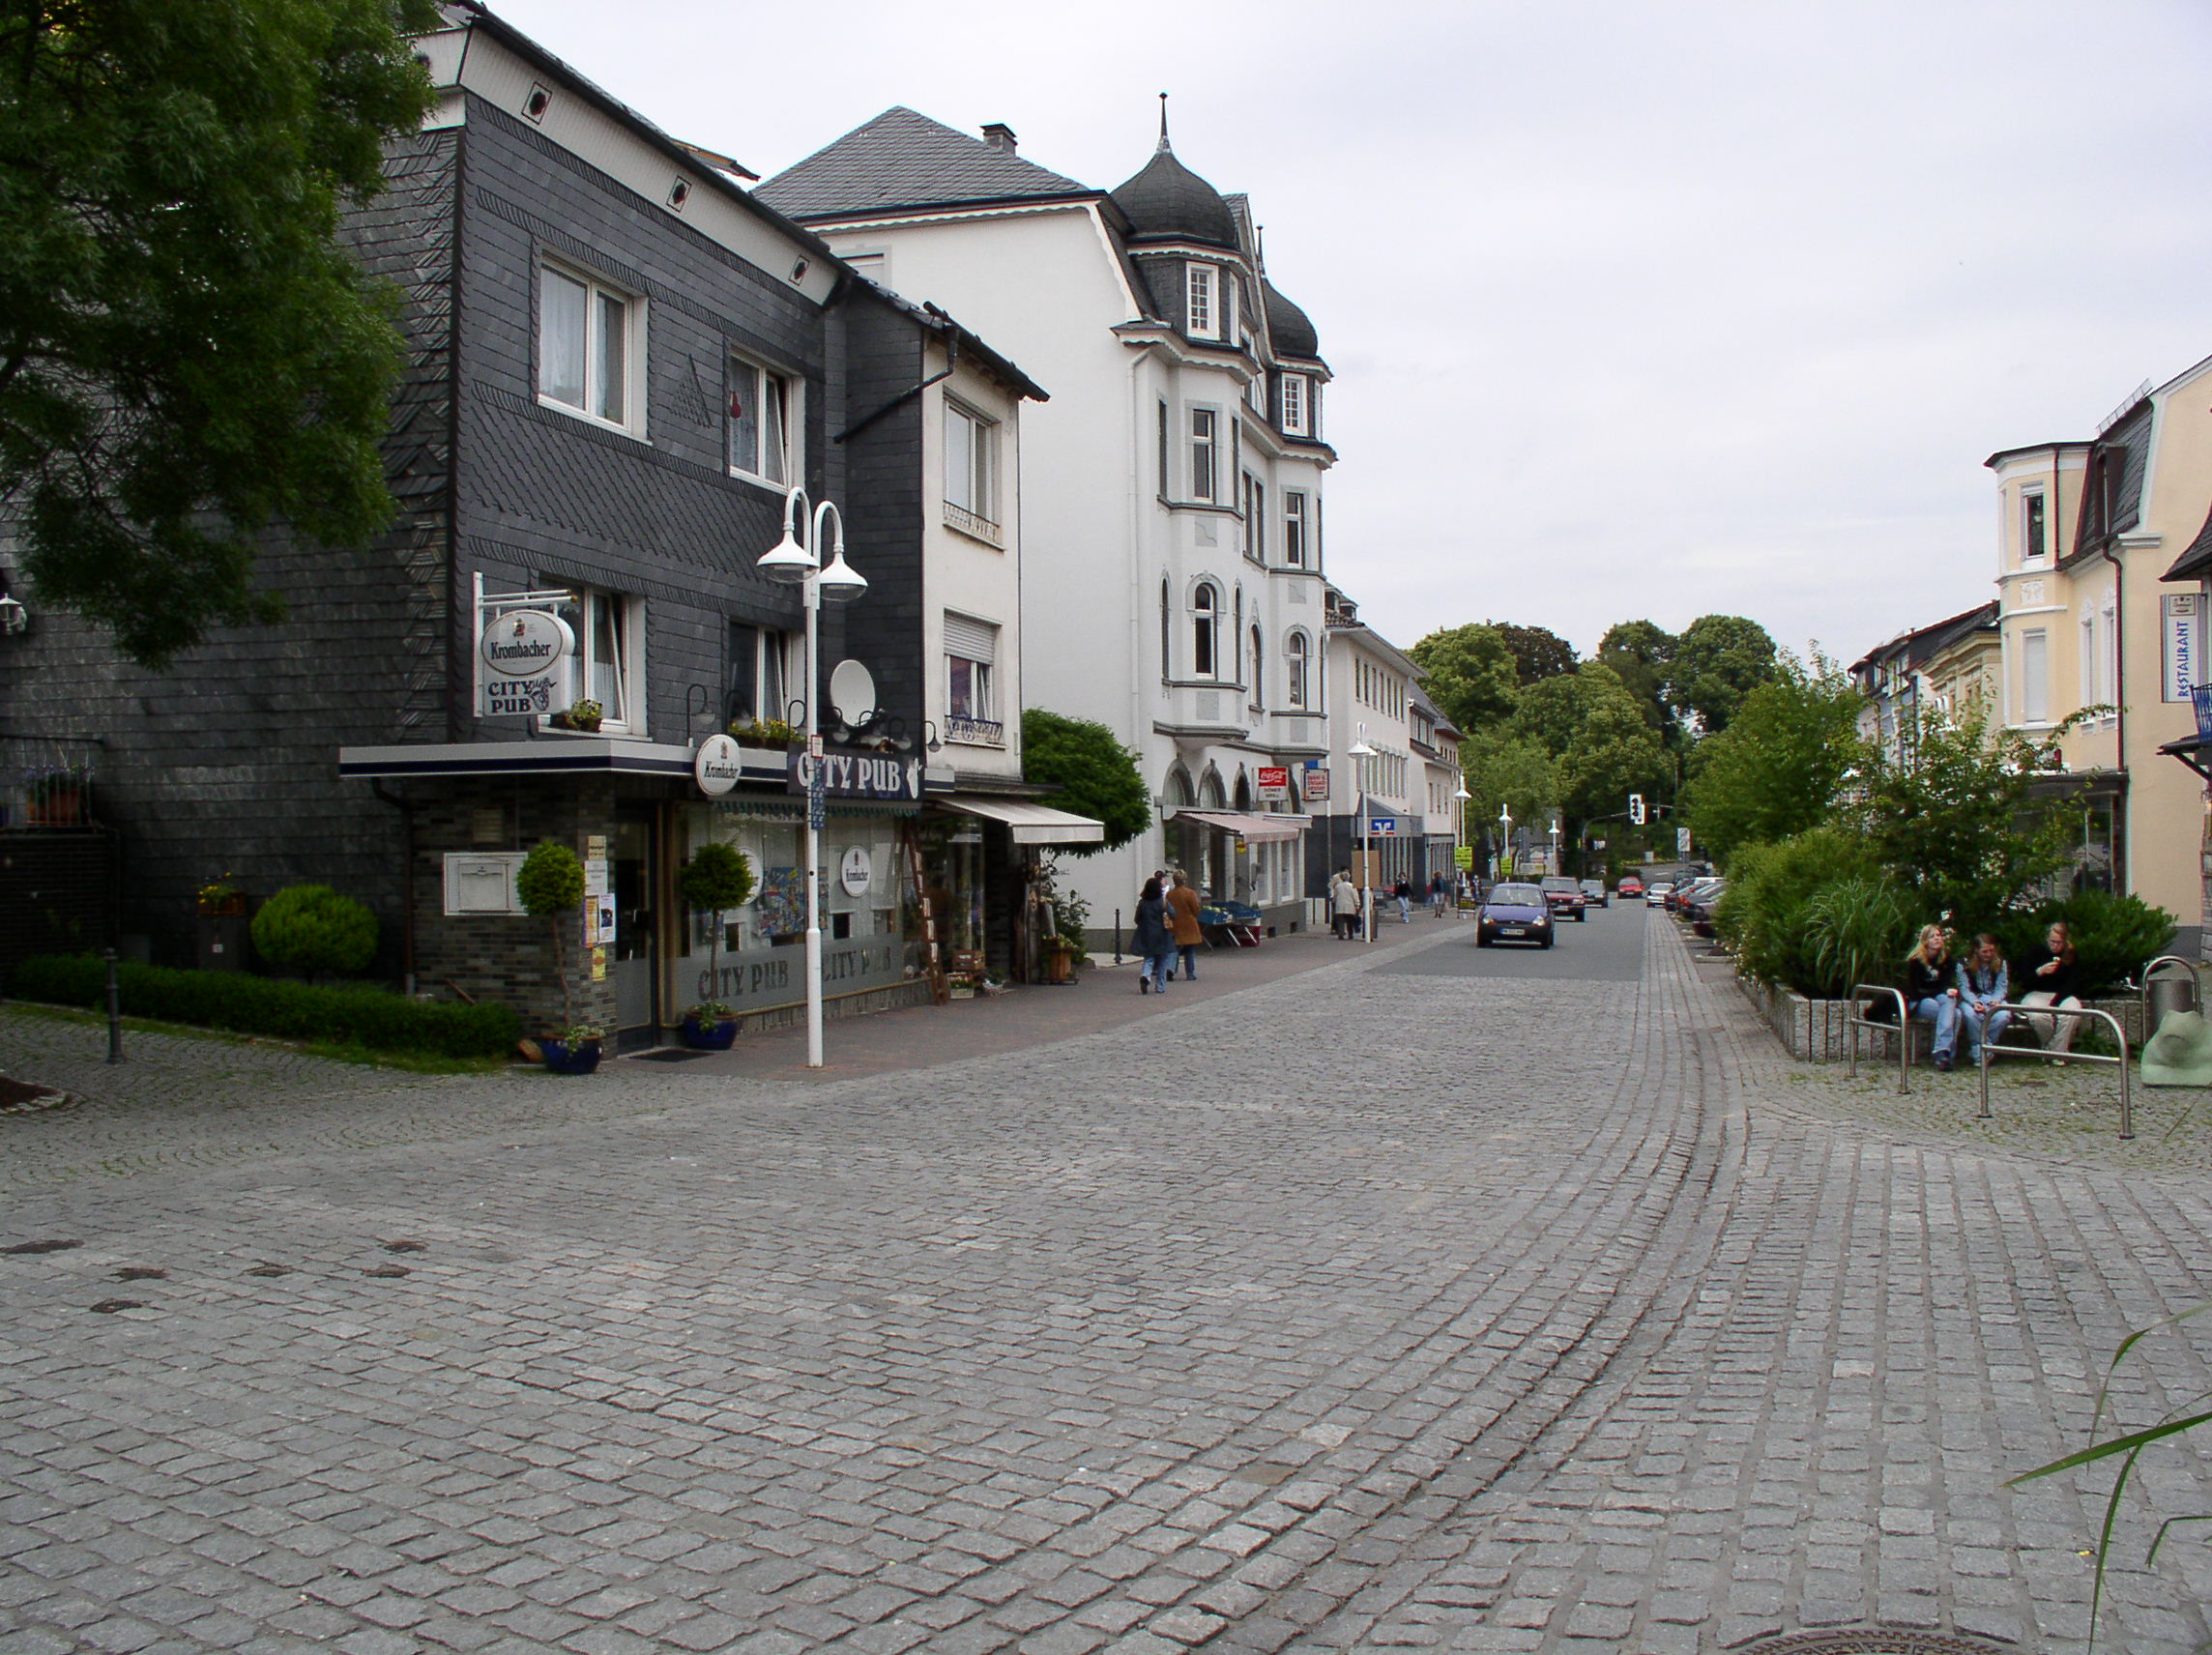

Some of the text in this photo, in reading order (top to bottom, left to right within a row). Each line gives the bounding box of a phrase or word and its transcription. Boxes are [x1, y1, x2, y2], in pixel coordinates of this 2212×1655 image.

[490, 639, 551, 659] Krombacher
[2176, 621, 2190, 697] RESTAURANT
[487, 680, 533, 696] CITY
[491, 698, 532, 713] PUB
[797, 750, 853, 790] CTY
[857, 757, 901, 792] PUB
[749, 959, 790, 993] PUB
